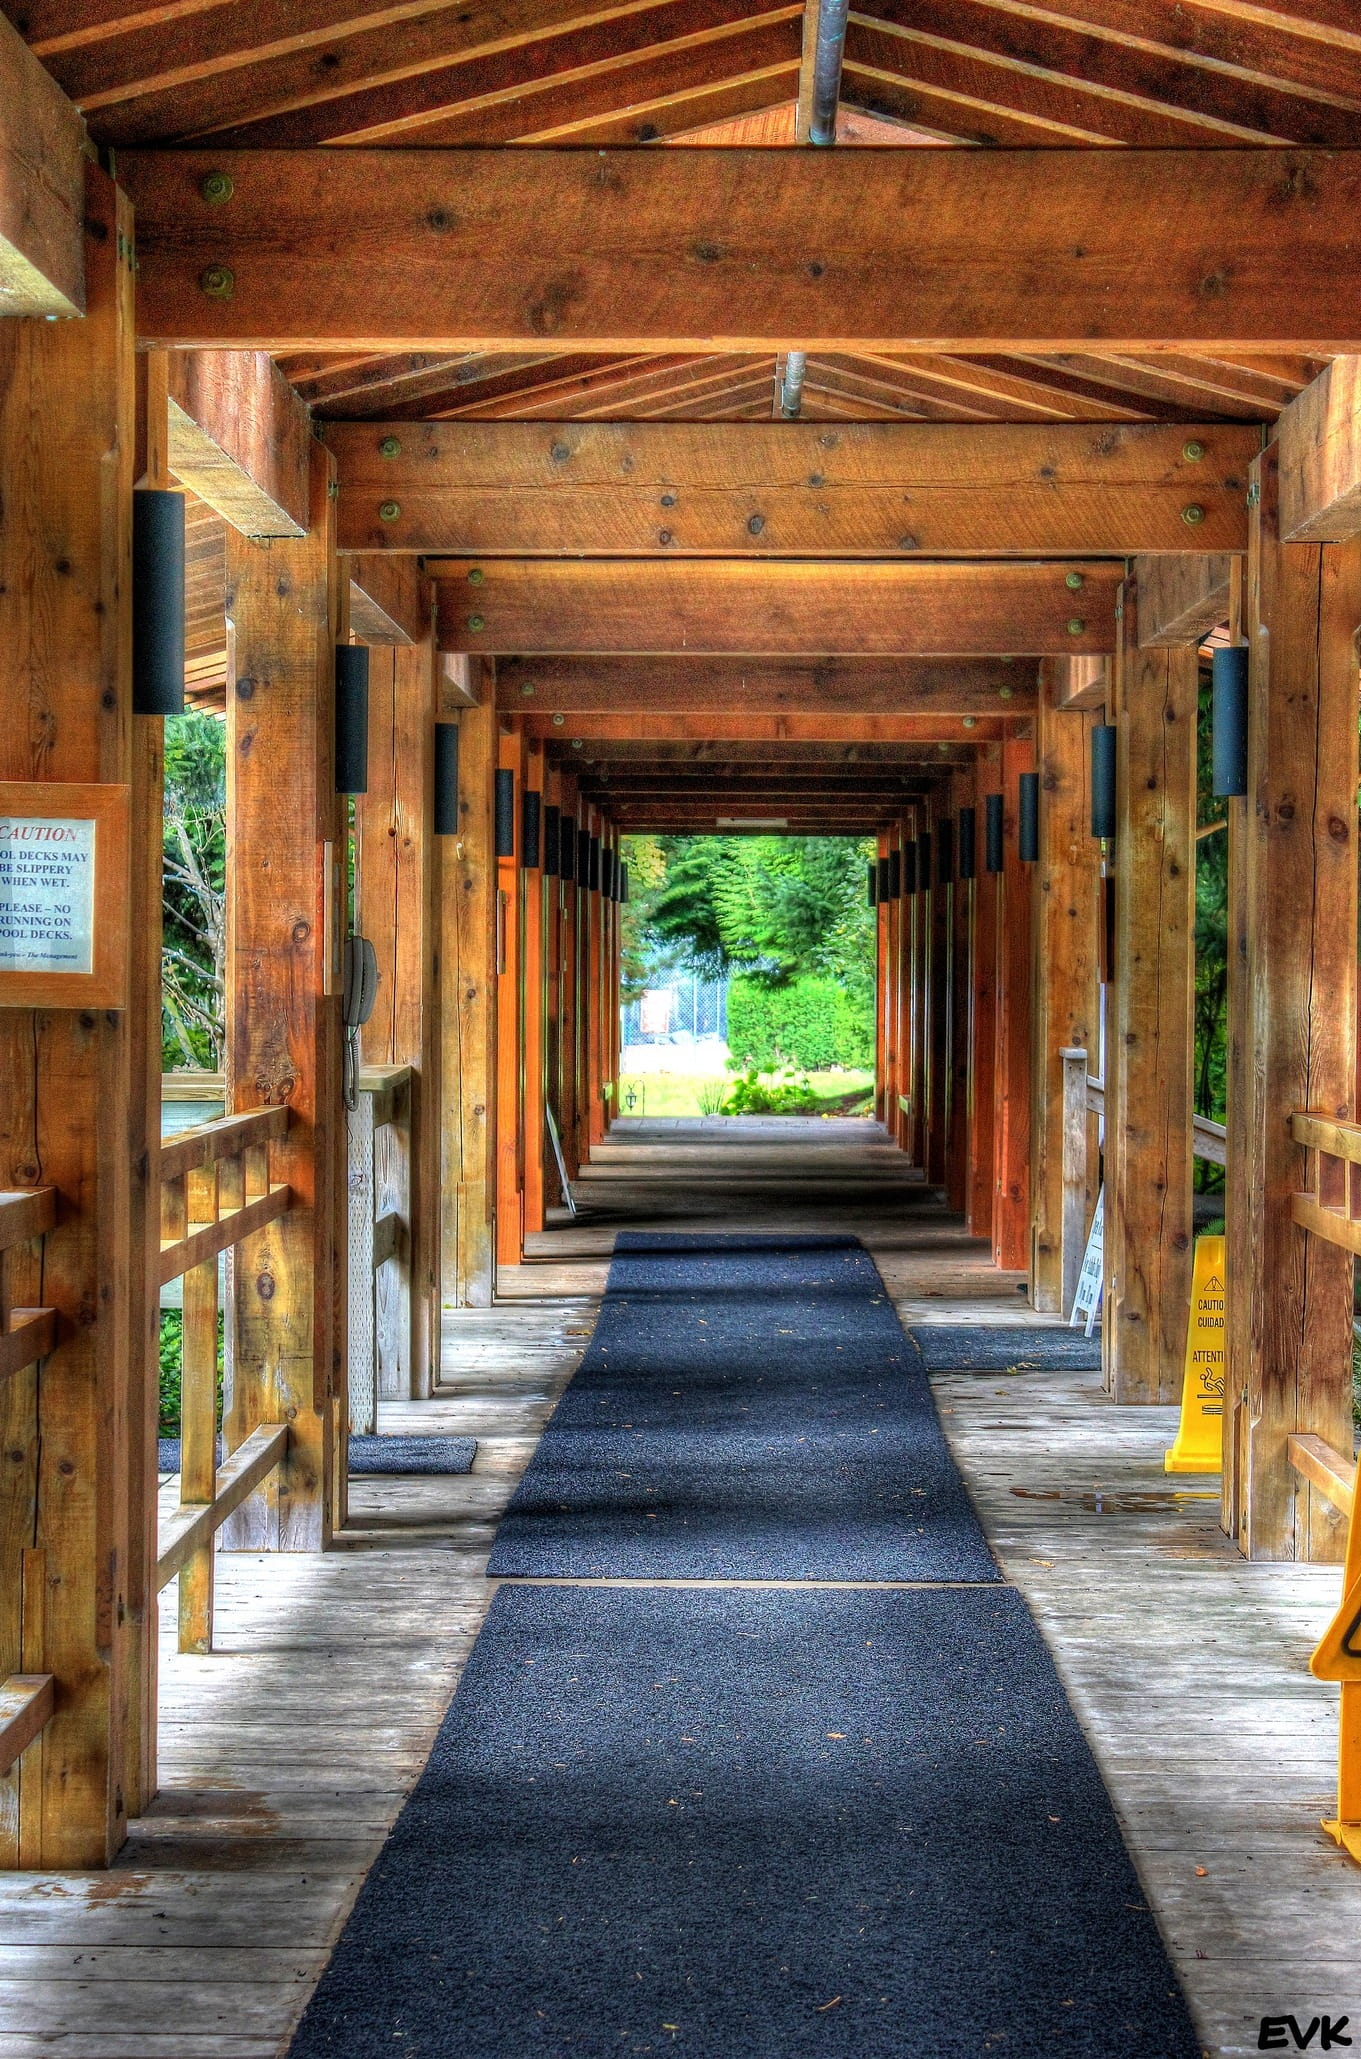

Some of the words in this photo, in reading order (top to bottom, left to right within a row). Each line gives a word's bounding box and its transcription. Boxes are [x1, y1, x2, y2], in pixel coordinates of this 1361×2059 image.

[0, 826, 78, 841] CAUTION
[0, 850, 16, 860] OL
[19, 851, 58, 861] DECKS
[61, 853, 88, 862] MAY
[0, 863, 13, 873] BE
[16, 864, 73, 875] SLIPPERY
[1, 876, 37, 887] WHEN
[40, 878, 70, 888] WET.
[0, 903, 43, 913] PLEASE
[54, 905, 71, 914] NO
[0, 916, 51, 927] RUNNING
[54, 918, 72, 927] ON
[0, 929, 27, 939] OOL
[30, 930, 73, 940] DECKS.
[1198, 1299, 1224, 1310] CAUTIO
[1198, 1317, 1224, 1327] CUIDAD
[1193, 1351, 1224, 1362] ATTENTI
